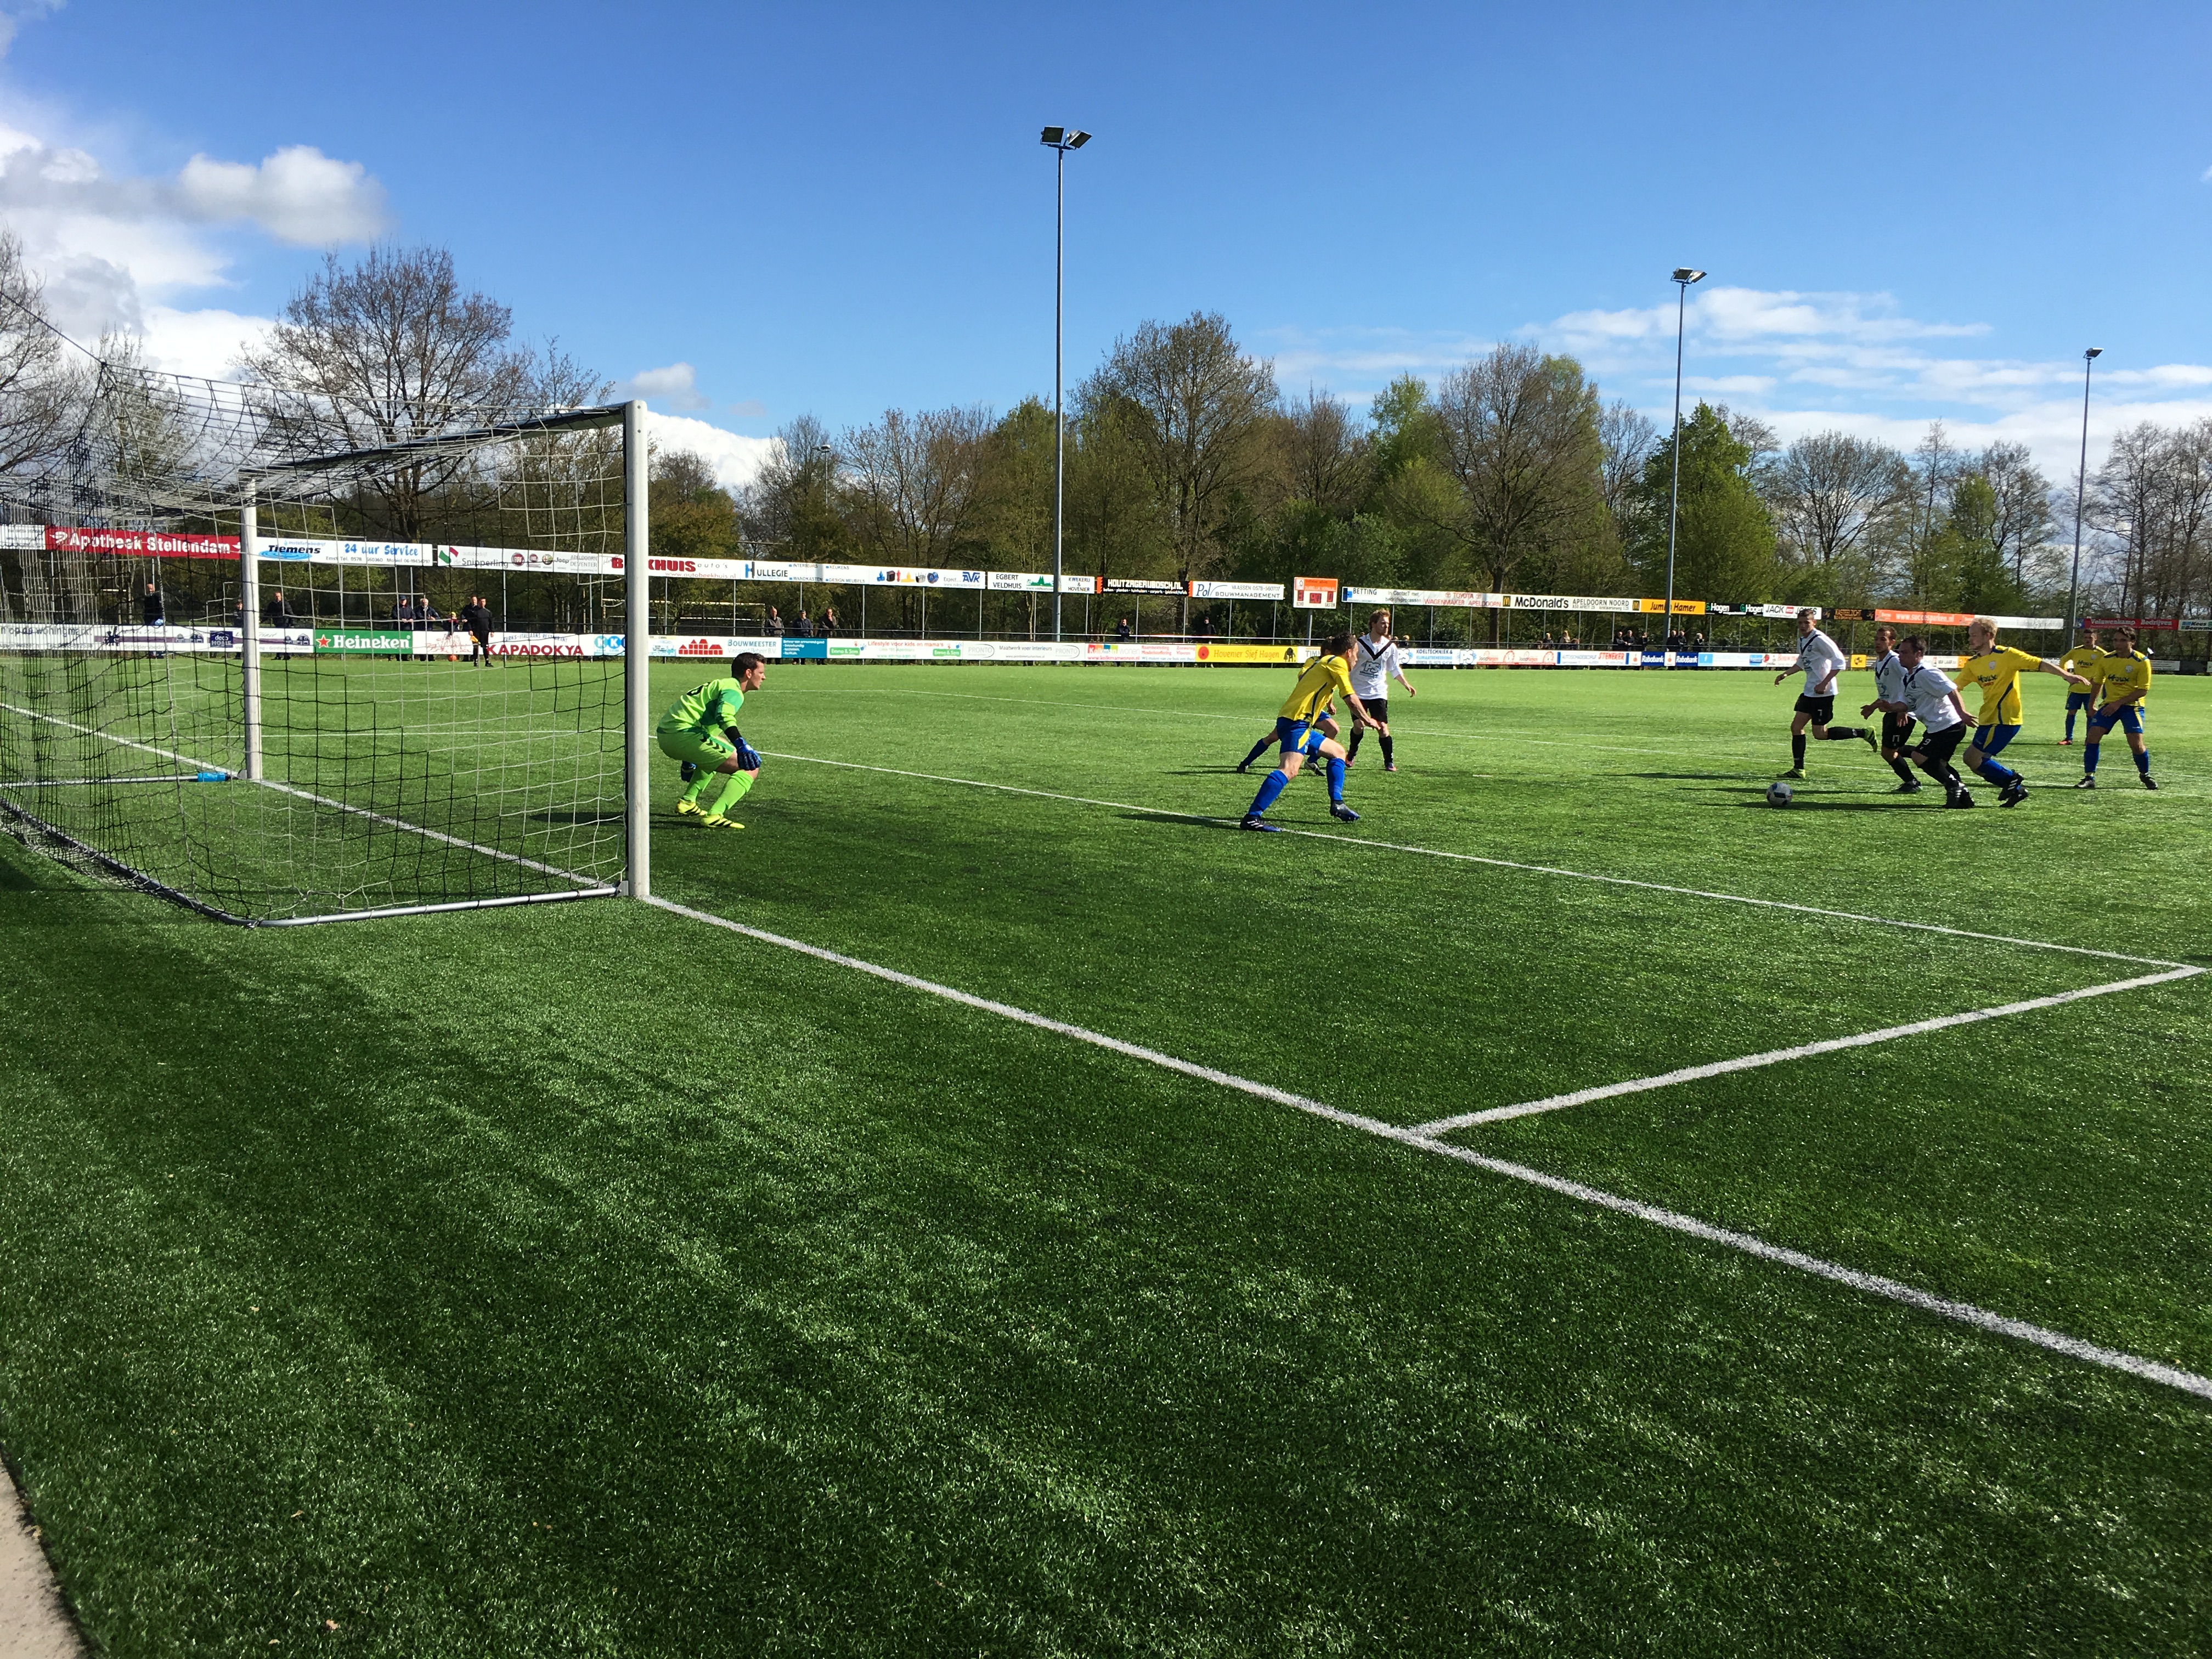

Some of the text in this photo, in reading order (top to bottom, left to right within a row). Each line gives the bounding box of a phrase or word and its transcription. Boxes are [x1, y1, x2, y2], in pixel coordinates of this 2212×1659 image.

[69, 533, 230, 554] Apotheek Stellendam
[268, 545, 321, 554] Tiemens
[344, 543, 419, 556] 24 uur Service
[462, 558, 509, 569] Snipperling
[993, 582, 1023, 590] VELDHUIS
[1311, 593, 1321, 603] 90
[1514, 596, 1569, 609] McDonald's
[1673, 602, 1697, 613] Hamer
[1765, 605, 1785, 614] JACK
[333, 635, 407, 650] Heineken
[728, 639, 776, 647] BOUWMEESTER
[487, 644, 584, 656] KAPADOKYA
[1214, 649, 1279, 660] Hovenier Sjef Hagen
[1598, 652, 1624, 661] STENEKER
[1641, 654, 1664, 663] Rabobank
[1676, 655, 1698, 663] Rabobank
